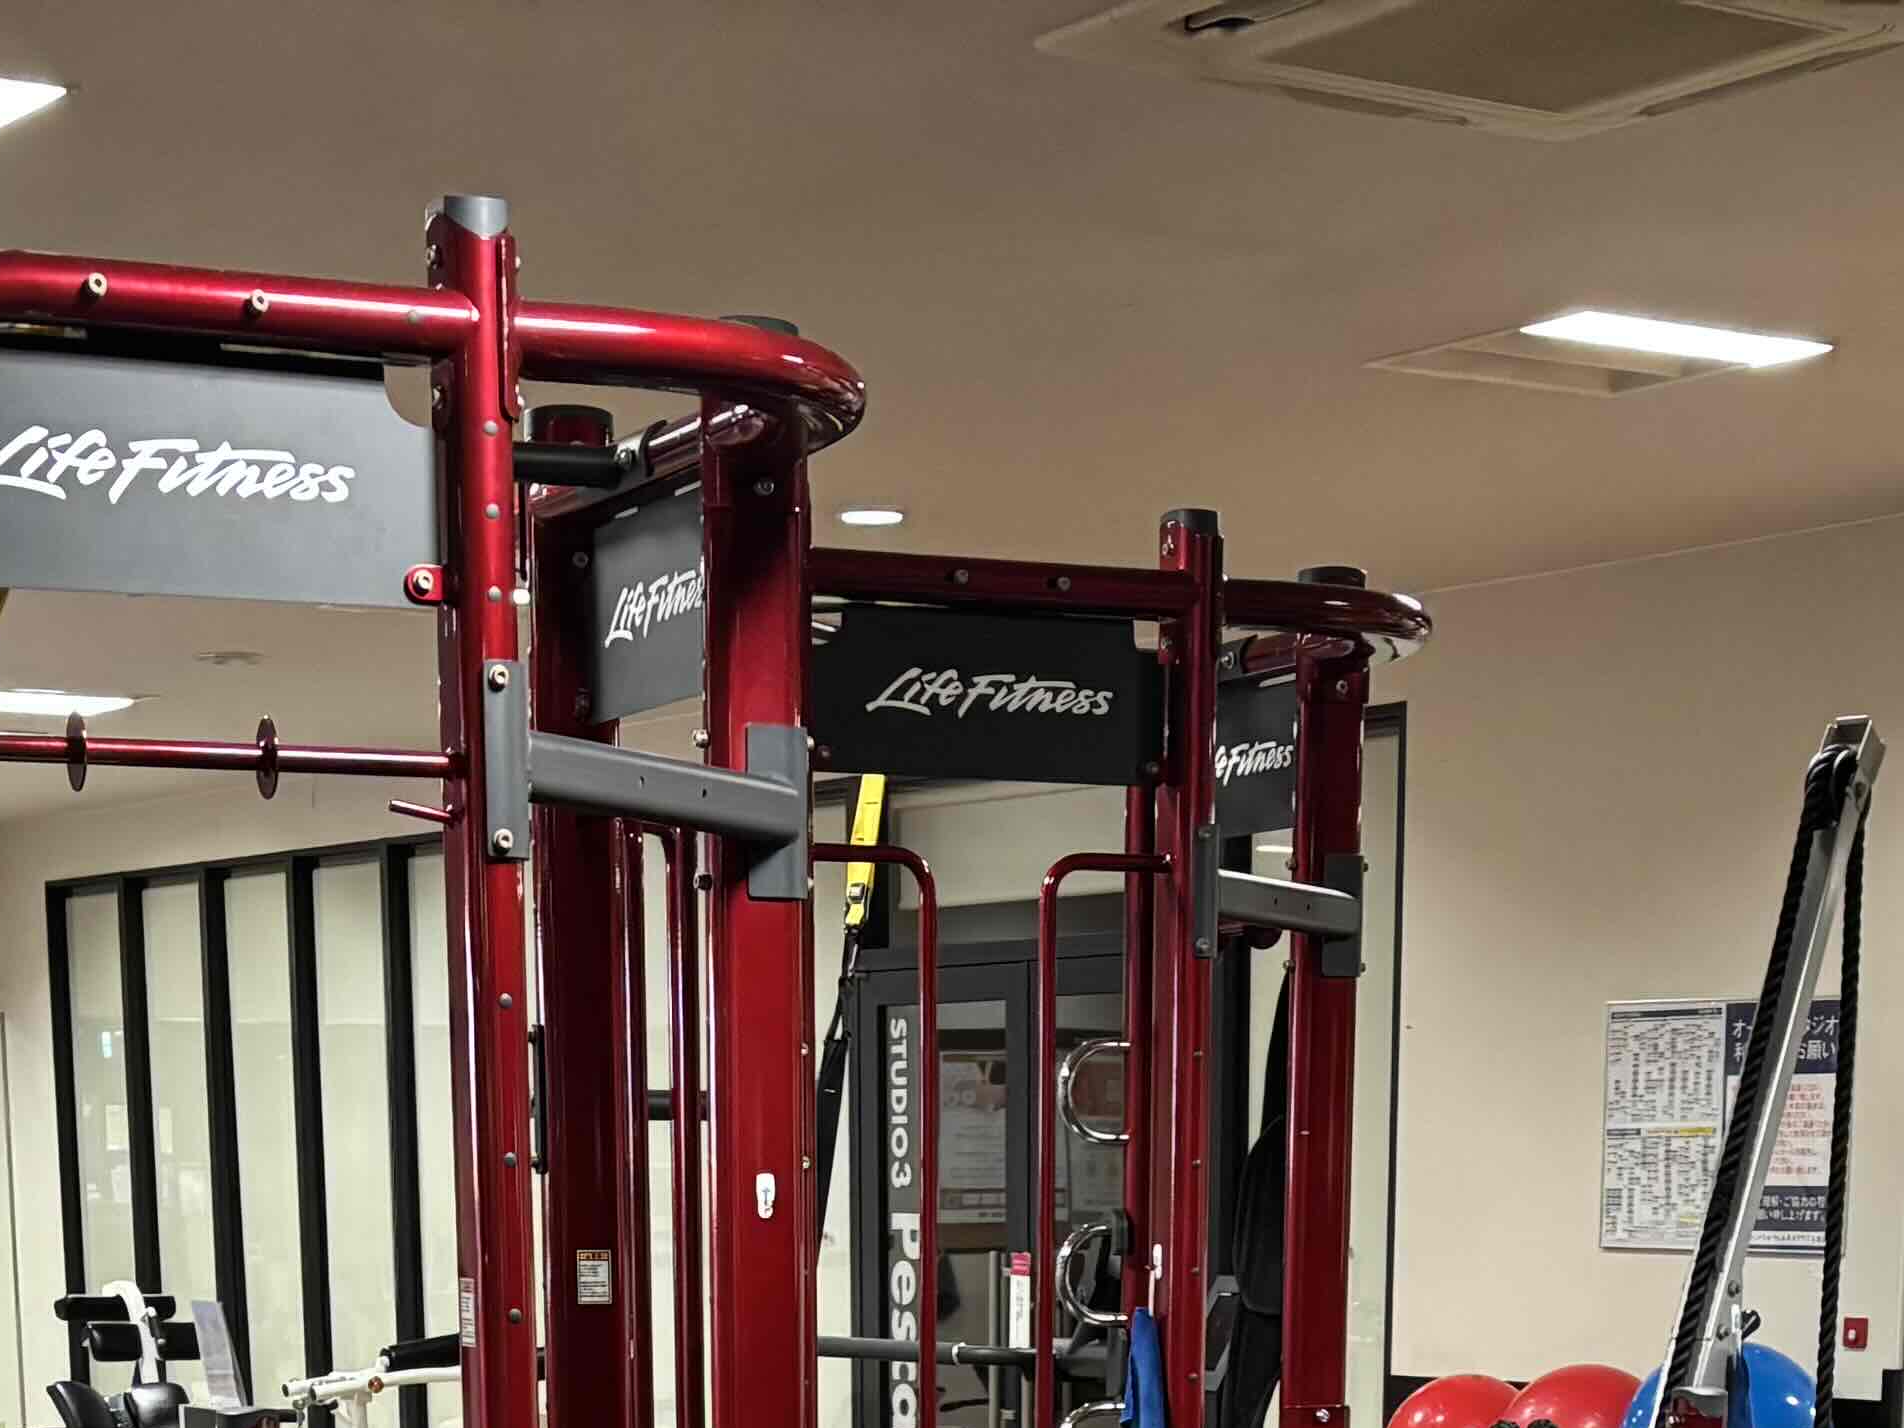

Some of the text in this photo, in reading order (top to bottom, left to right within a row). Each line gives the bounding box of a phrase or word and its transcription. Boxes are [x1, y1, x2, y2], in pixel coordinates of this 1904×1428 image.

[108, 438, 356, 505] Fitness
[604, 568, 704, 649] Life Fitnes
[865, 666, 1114, 721] Life Fitness
[1222, 740, 1295, 787] Fitness
[888, 1016, 911, 1190] STUDIO3
